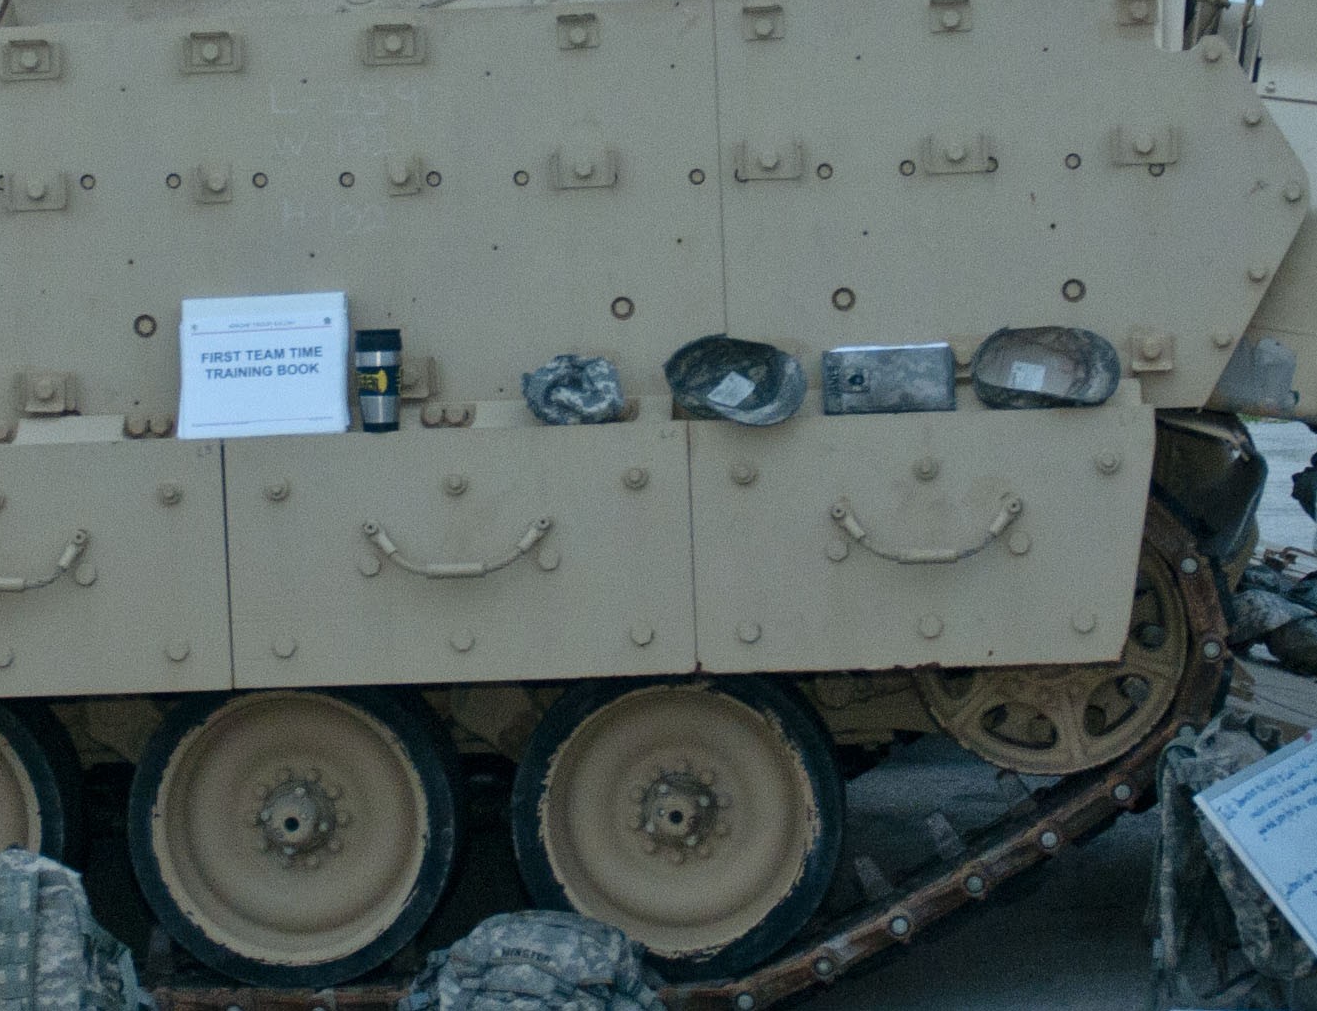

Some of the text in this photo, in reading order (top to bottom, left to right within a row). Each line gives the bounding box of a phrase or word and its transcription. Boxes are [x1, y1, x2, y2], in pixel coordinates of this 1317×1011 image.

[200, 345, 324, 364] FIRST TEAM TIME
[205, 363, 320, 380] TRAINING BOOK
